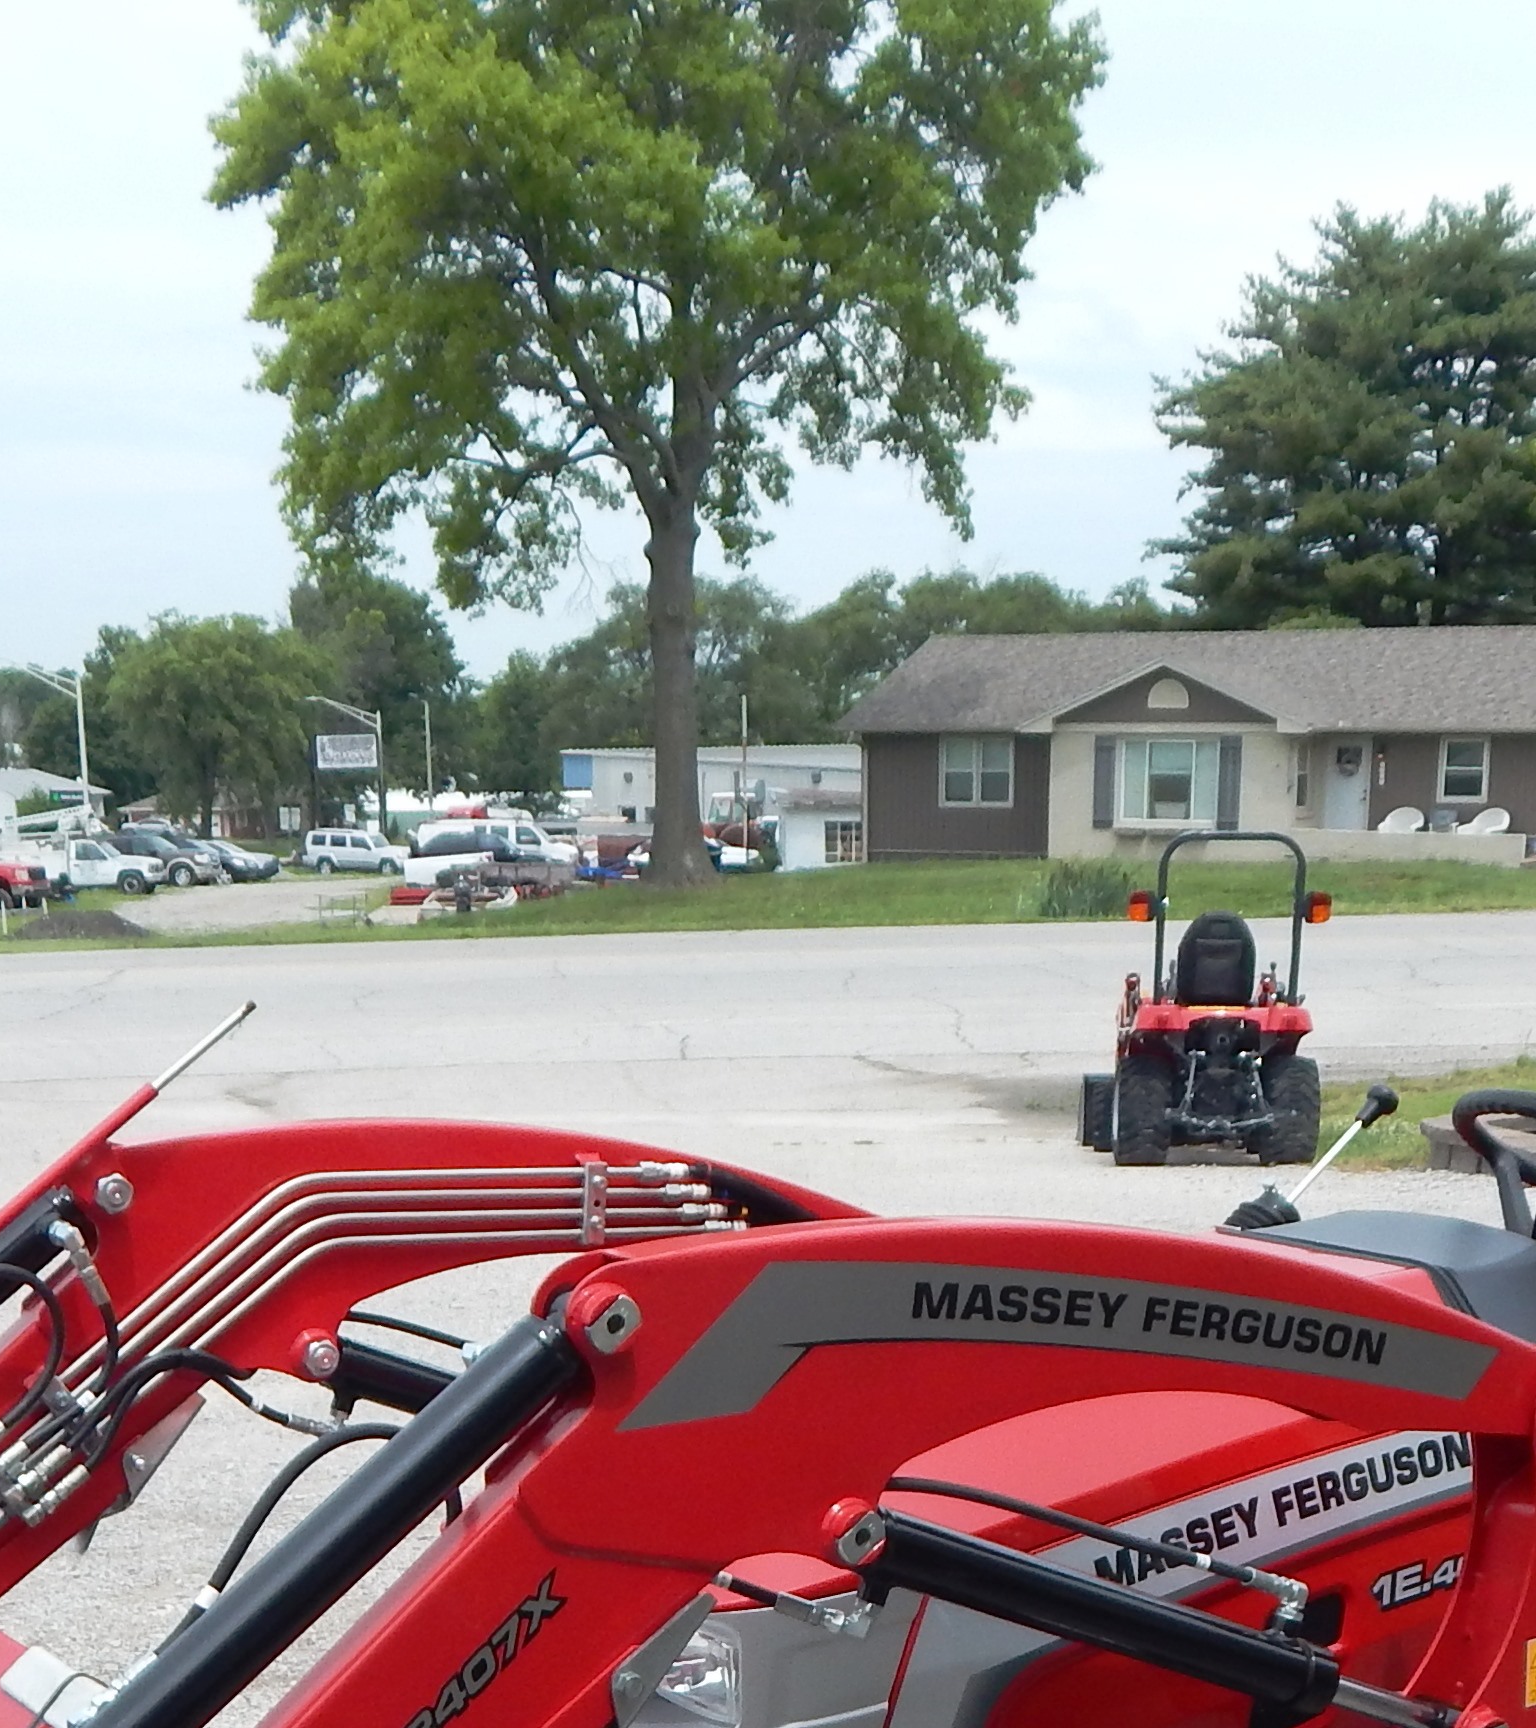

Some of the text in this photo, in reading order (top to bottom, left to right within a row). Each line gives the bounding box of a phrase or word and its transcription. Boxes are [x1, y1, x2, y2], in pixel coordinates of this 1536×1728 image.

[912, 1281, 1387, 1366] MASSEY FERGUSON
[1093, 1431, 1472, 1586] MASSEY FERGUSON
[1370, 1555, 1465, 1609] 1E.4
